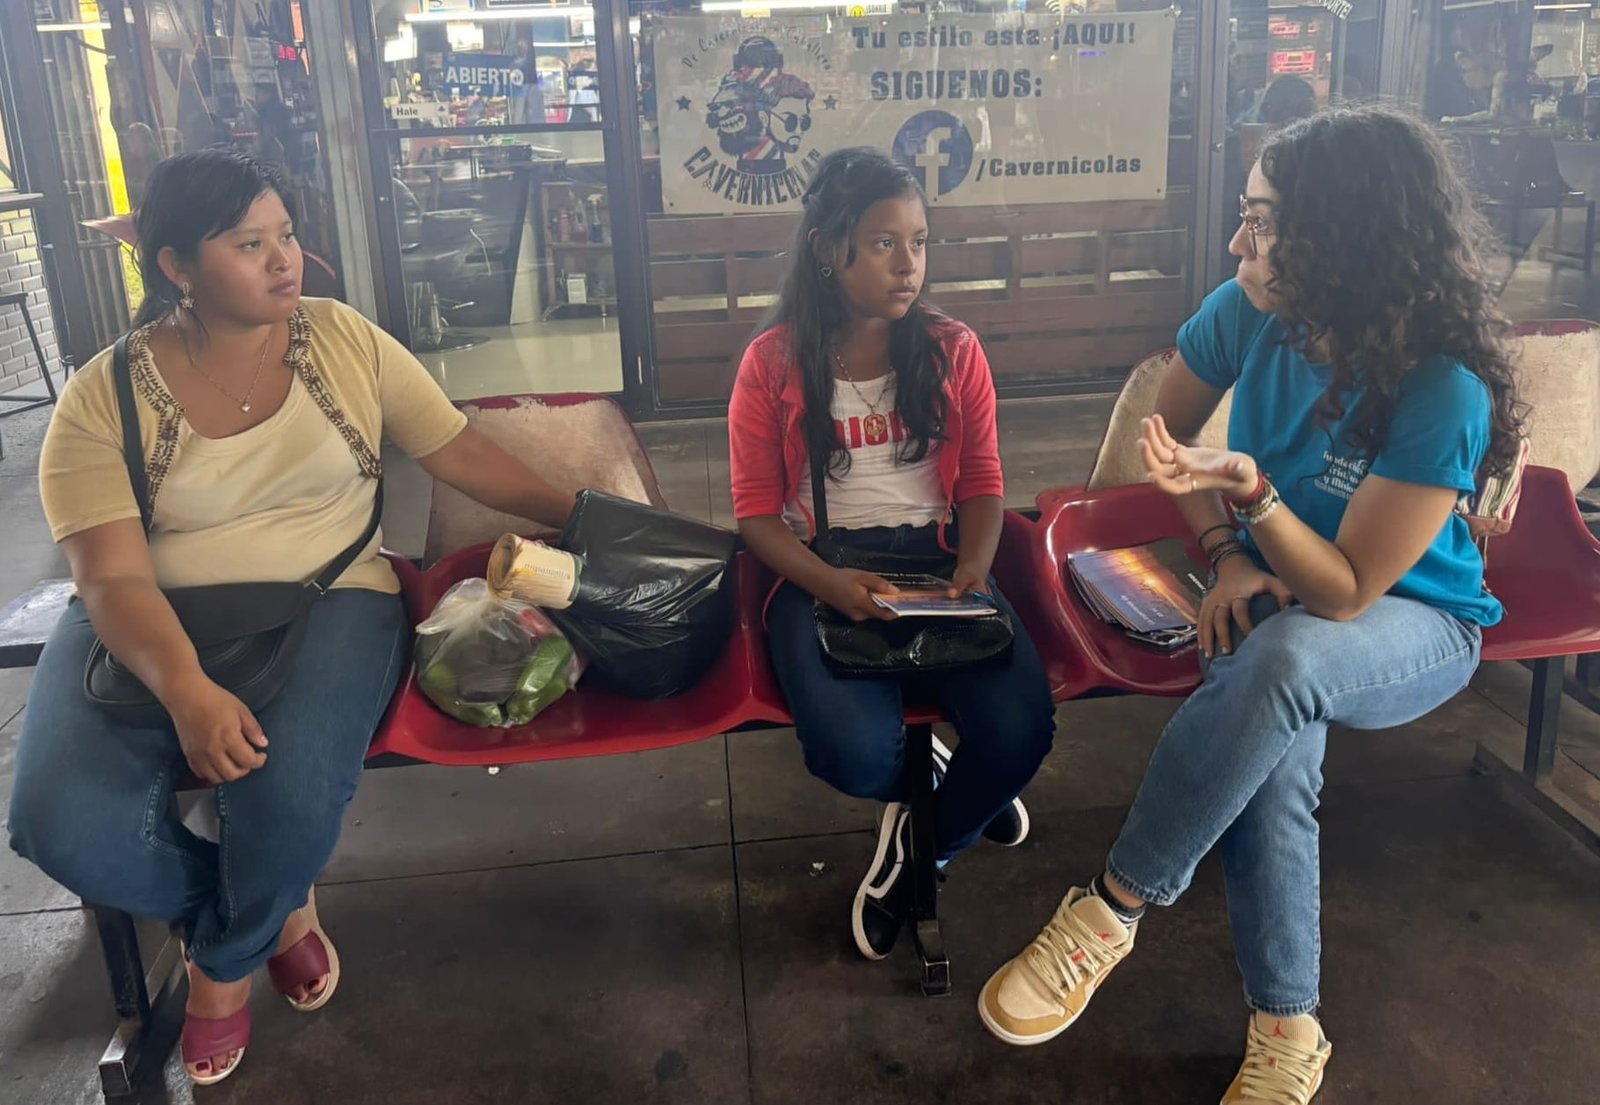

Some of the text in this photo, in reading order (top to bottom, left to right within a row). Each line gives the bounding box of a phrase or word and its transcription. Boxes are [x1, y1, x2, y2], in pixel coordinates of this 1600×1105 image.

[851, 22, 1136, 51] Tu estilo esta ¡AQUI!
[446, 66, 524, 86] ABIERTO
[871, 68, 1043, 101] SIGUENOS:
[396, 106, 419, 116] Hale
[975, 154, 1142, 182] /Cavernicolas
